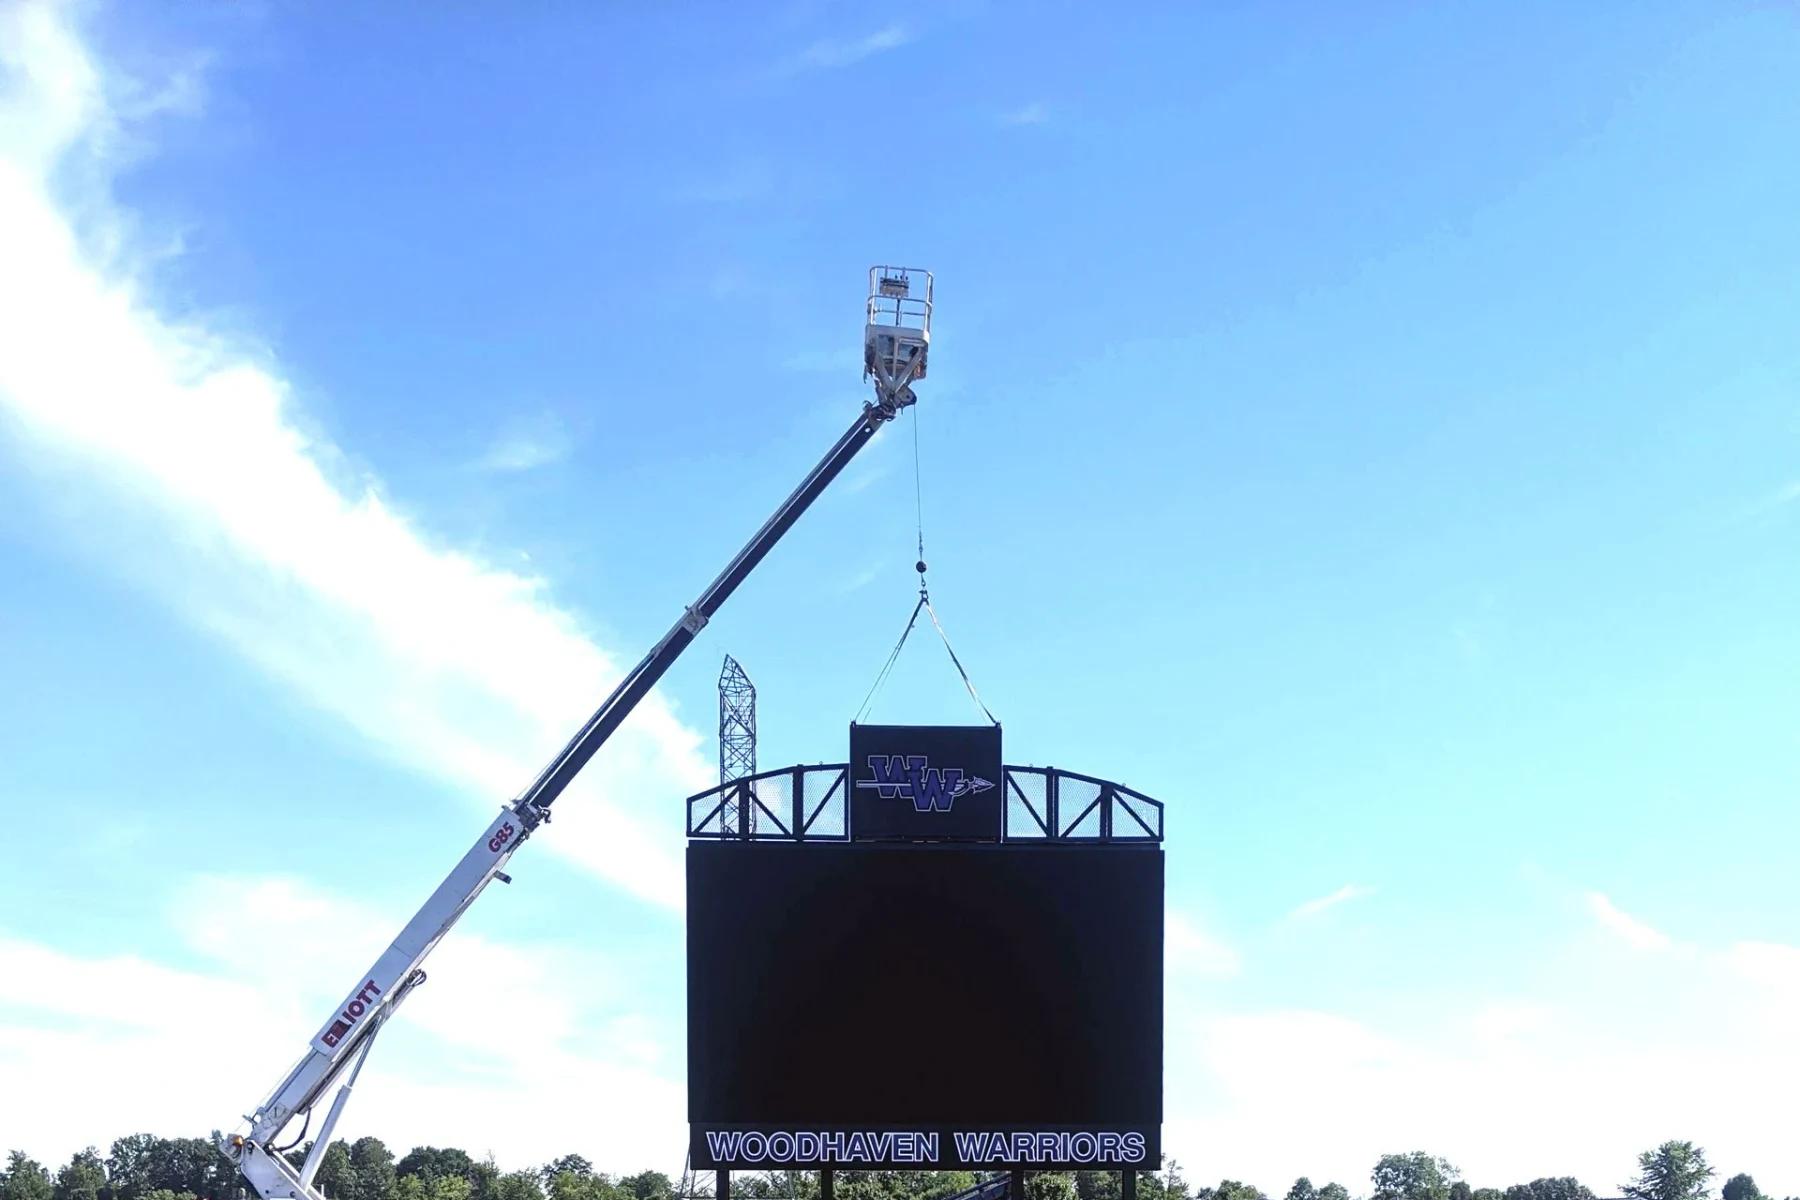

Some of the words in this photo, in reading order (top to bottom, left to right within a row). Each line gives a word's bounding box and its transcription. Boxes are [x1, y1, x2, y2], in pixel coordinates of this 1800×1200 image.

[488, 821, 515, 853] G85
[706, 1131, 939, 1162] WOODHAVEN
[953, 1131, 1146, 1162] WARRIORS
